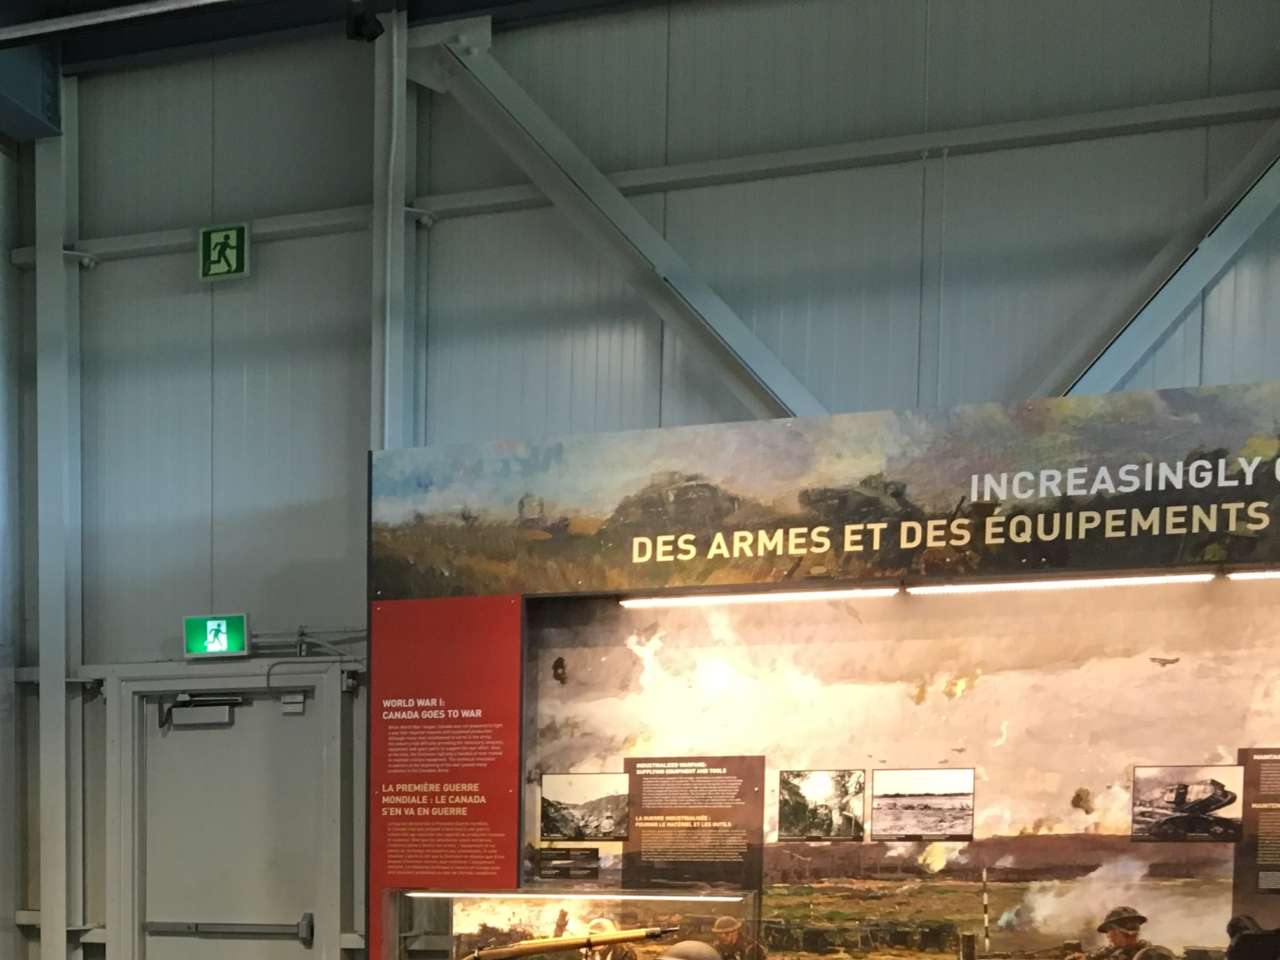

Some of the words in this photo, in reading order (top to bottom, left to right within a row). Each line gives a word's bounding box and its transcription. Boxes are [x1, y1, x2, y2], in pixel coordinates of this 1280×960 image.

[970, 456, 1262, 503] INCREASINGLY
[632, 534, 697, 564] DES
[707, 526, 830, 559] ARMES
[843, 522, 888, 552] ET
[900, 518, 971, 549] DES
[984, 501, 1270, 545] ÉQUIPEMENTS
[382, 699, 415, 707] WORLD
[417, 698, 437, 707] WAR
[440, 698, 445, 706] I:
[382, 711, 418, 719] CANADA
[421, 710, 445, 719] GOES
[447, 710, 458, 718] TO
[460, 709, 482, 718] WAR
[382, 784, 393, 792] LA
[396, 782, 440, 792] PREMIÈRE
[382, 796, 427, 804] MONDIALE
[435, 796, 446, 804] LE
[382, 807, 401, 815] S'EN
